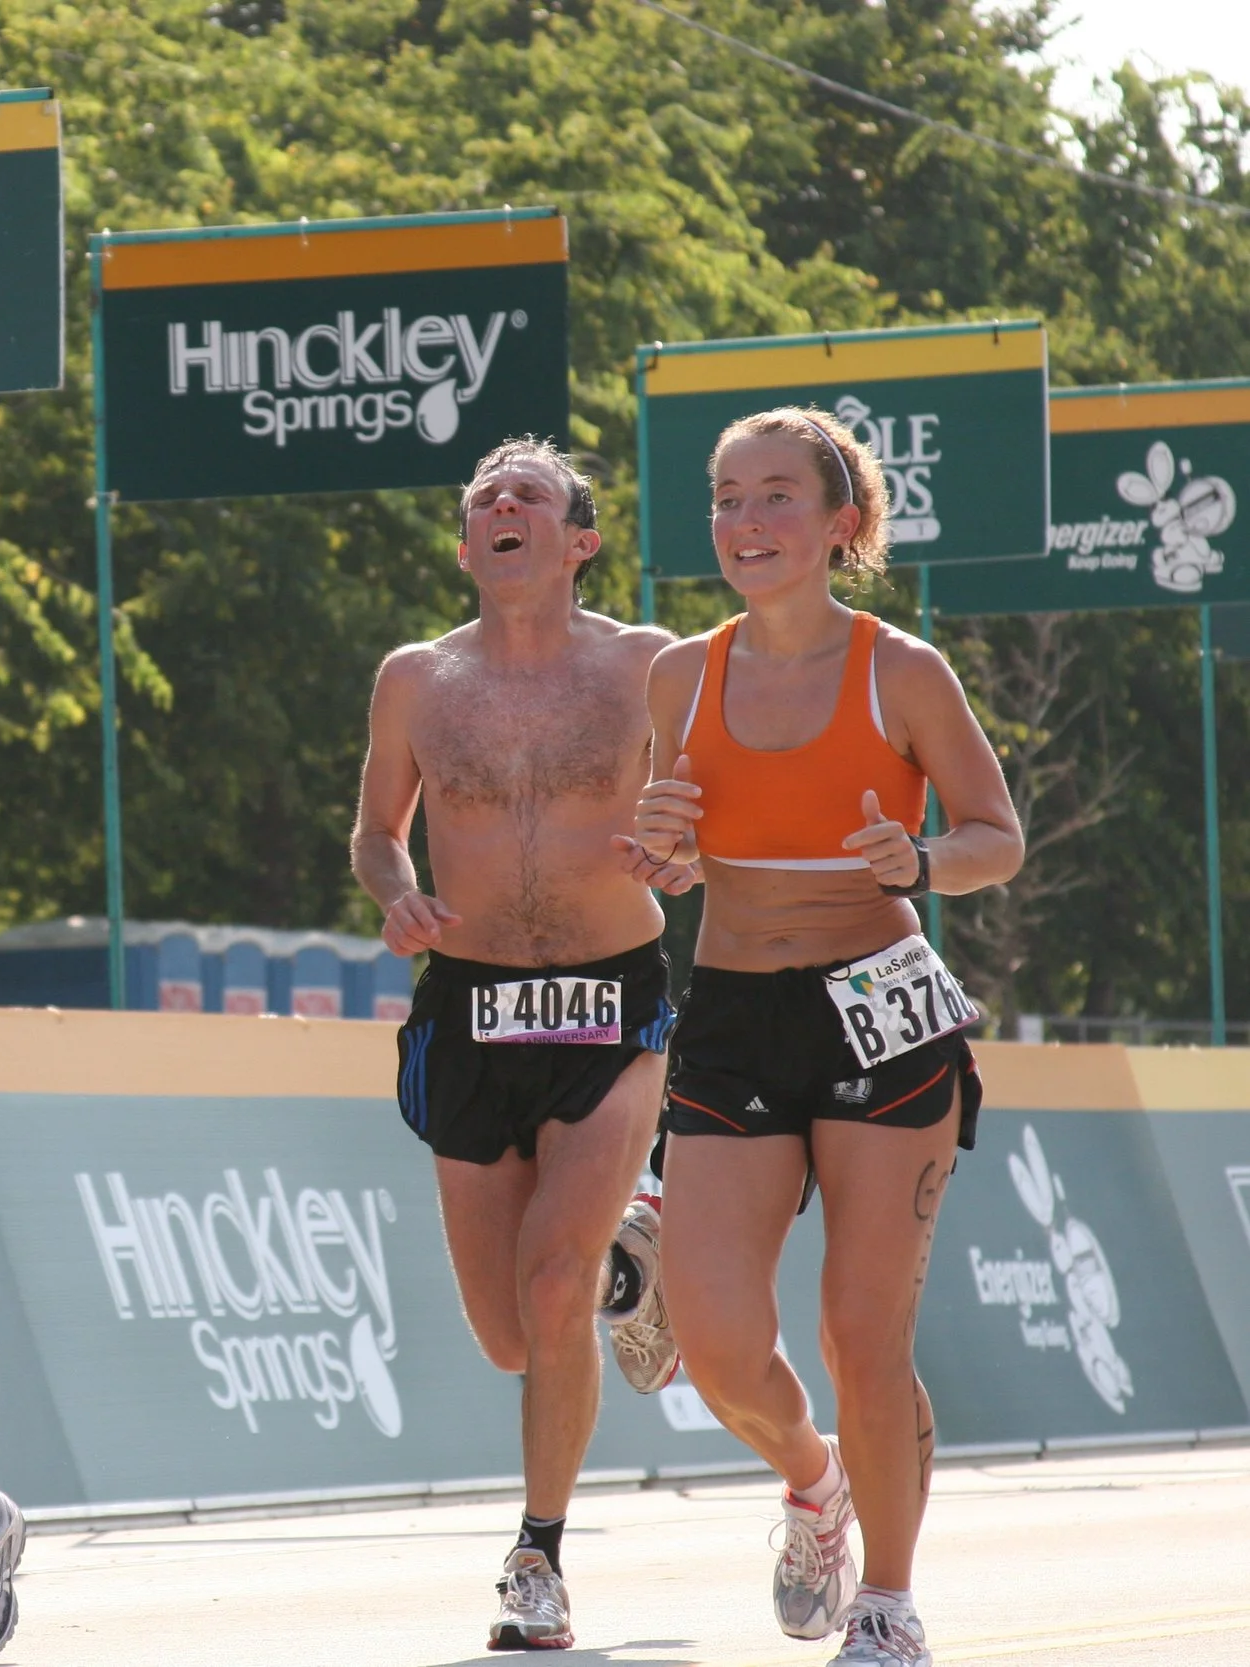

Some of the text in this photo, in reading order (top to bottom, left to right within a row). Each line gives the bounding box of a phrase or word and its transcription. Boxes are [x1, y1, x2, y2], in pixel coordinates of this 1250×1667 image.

[243, 390, 413, 447] Springs
[876, 950, 922, 979] LaSalle
[477, 981, 616, 1031] B 4046
[845, 1003, 886, 1061] B
[525, 1028, 610, 1044] ANNIVERSARY
[190, 1320, 356, 1433] Springs
